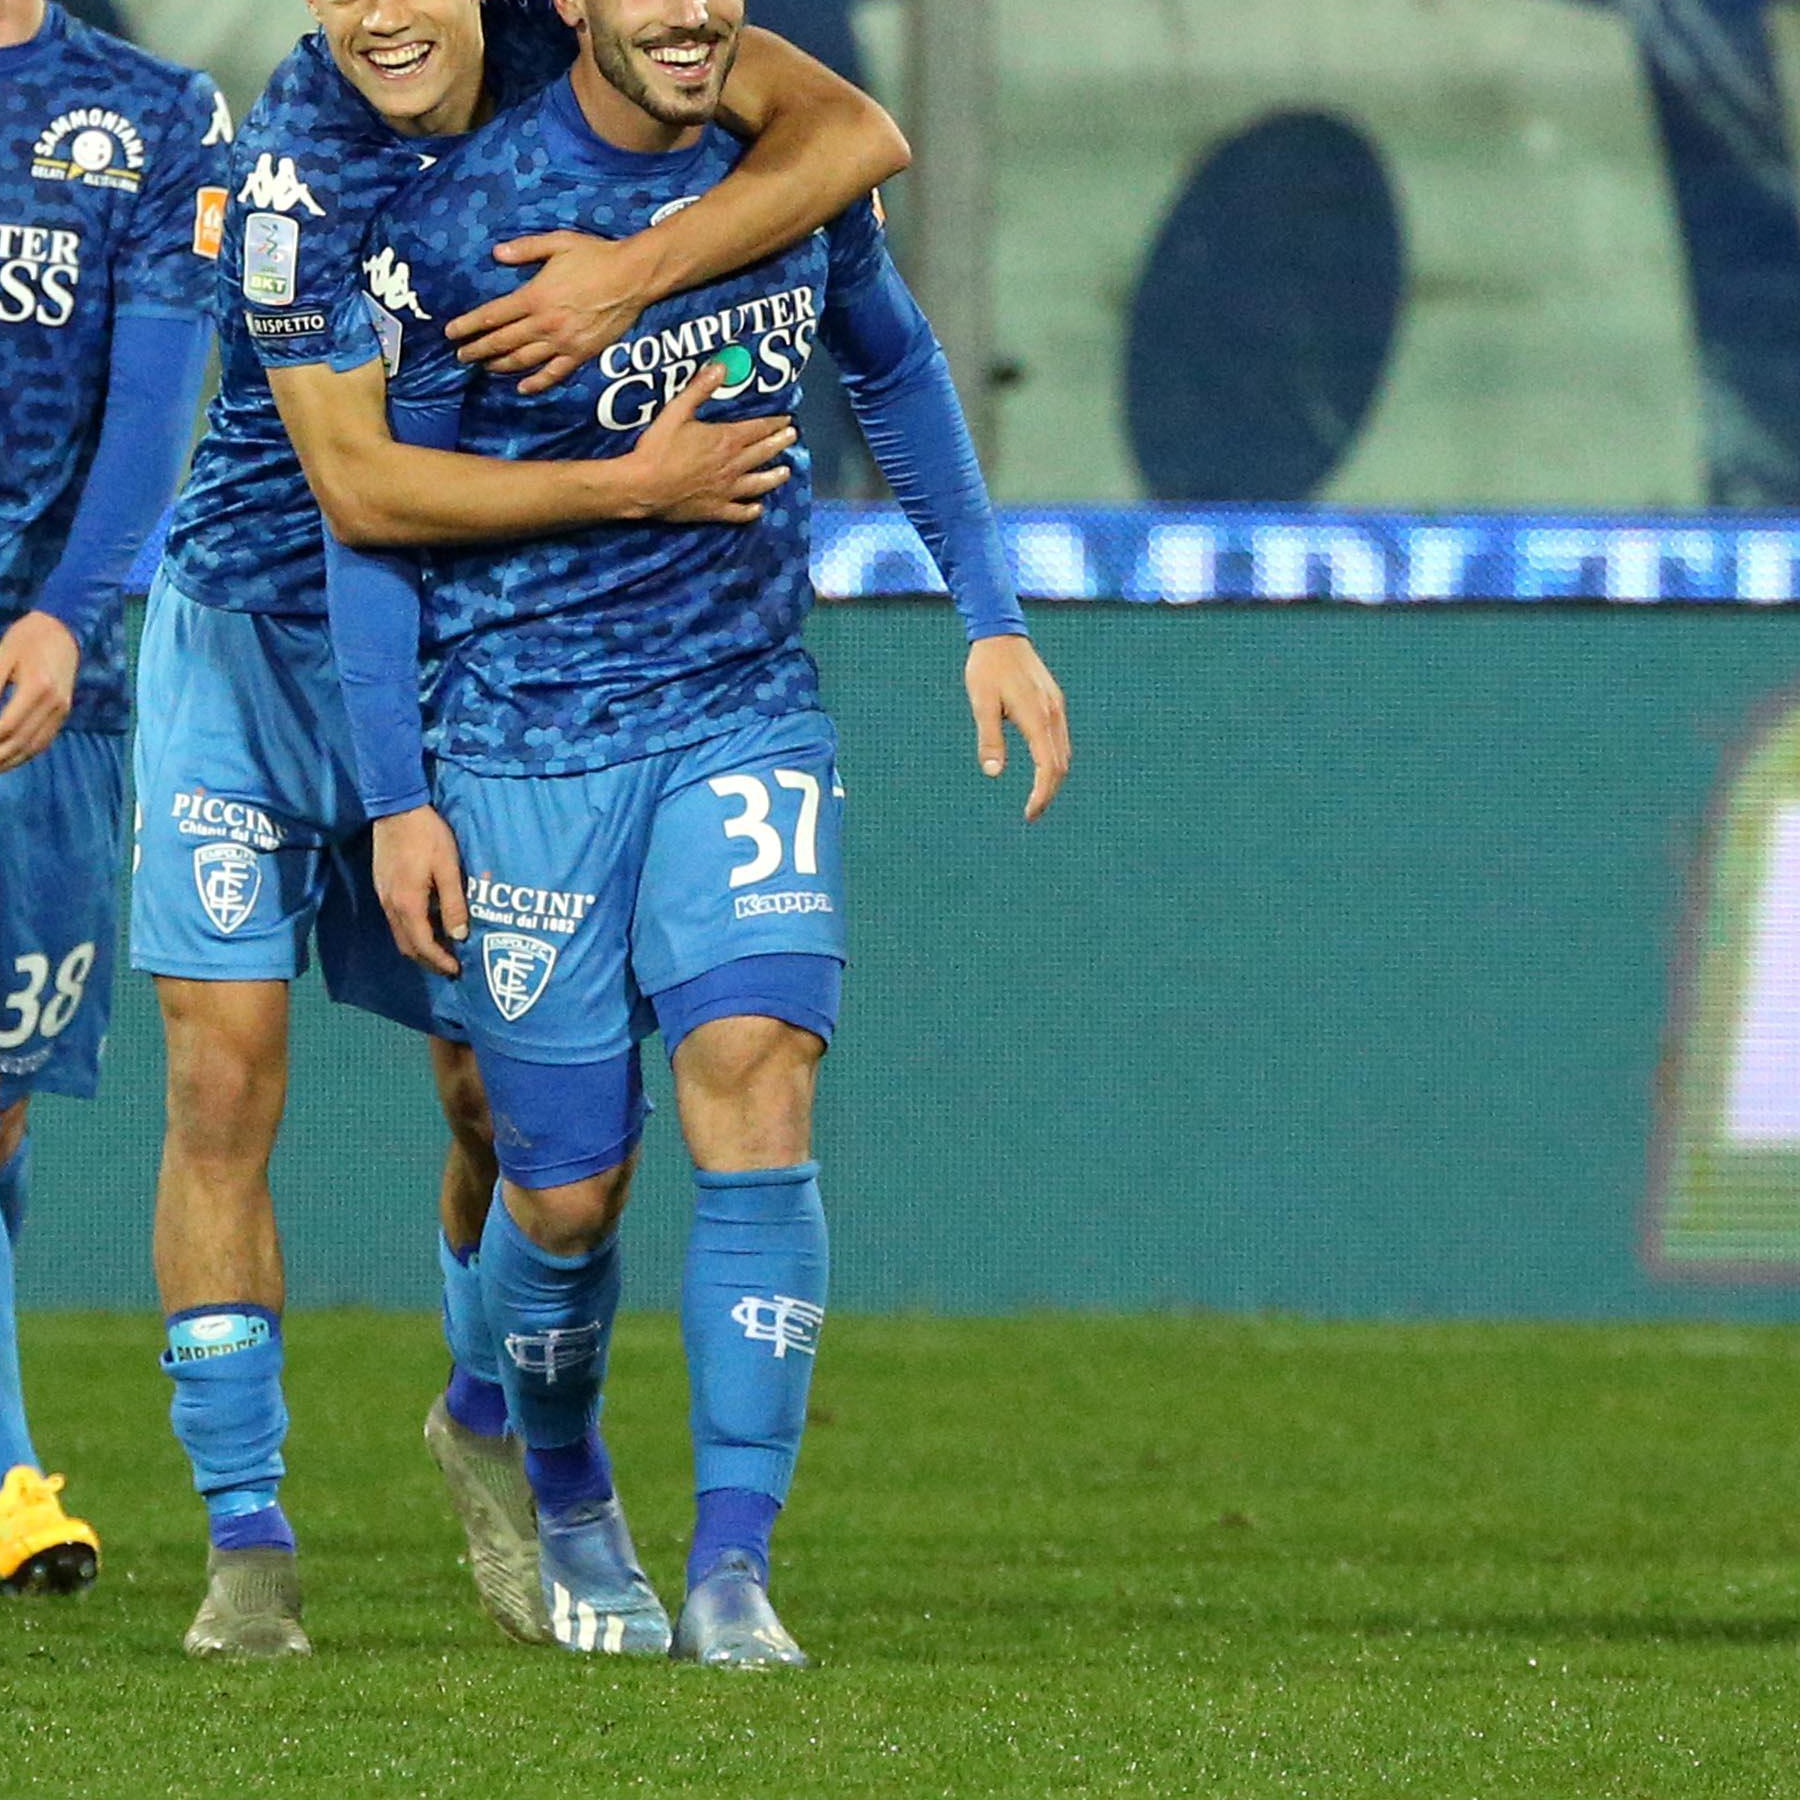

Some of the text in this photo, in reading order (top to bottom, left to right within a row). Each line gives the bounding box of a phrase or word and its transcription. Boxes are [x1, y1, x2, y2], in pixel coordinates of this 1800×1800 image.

[33, 107, 145, 169] SAMMONTANA
[250, 275, 287, 293] BKT
[255, 314, 325, 334] RISPETTO
[599, 286, 817, 380] COMPUTER
[709, 768, 820, 889] 37
[734, 891, 834, 919] Kappa
